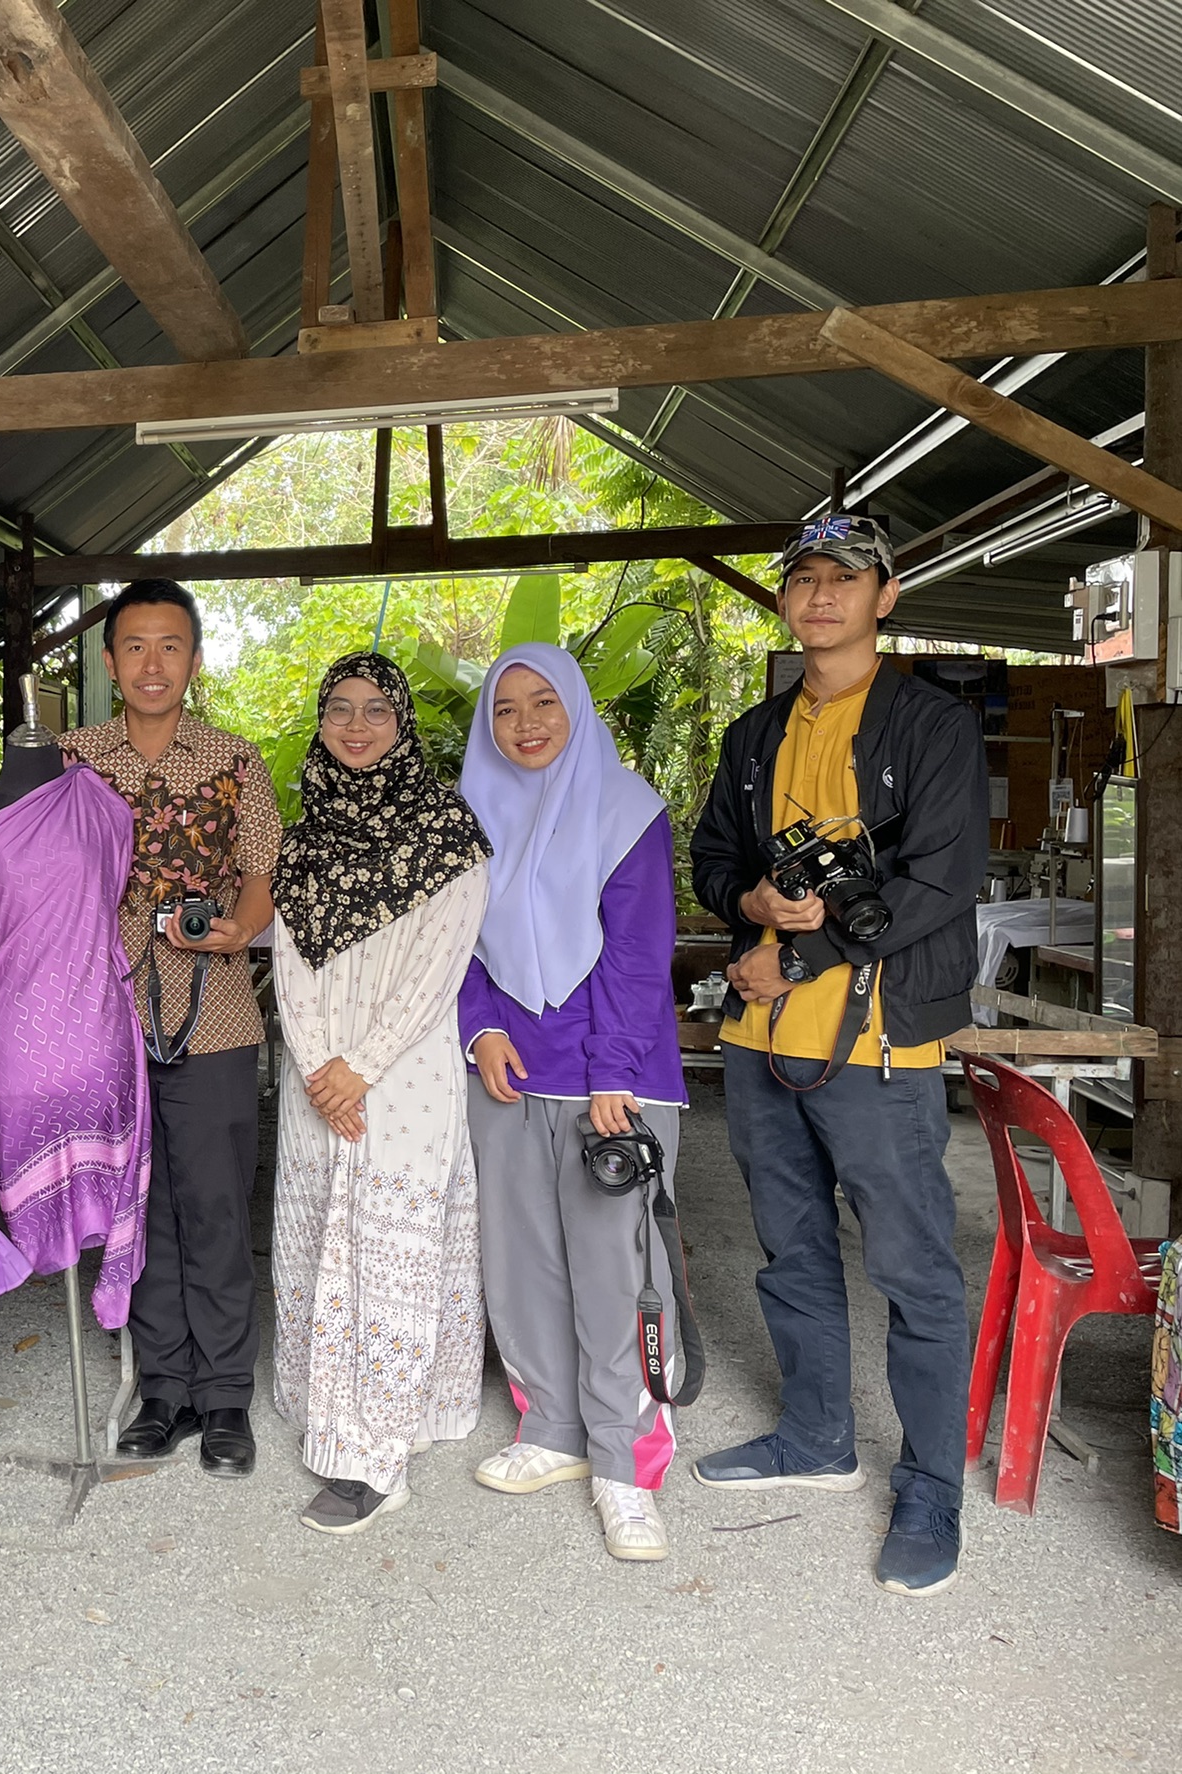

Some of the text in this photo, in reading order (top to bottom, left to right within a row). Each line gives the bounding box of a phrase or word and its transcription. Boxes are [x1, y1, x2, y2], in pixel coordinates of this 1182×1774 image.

[854, 962, 873, 995] Can
[646, 1323, 661, 1376] EOS 6D
